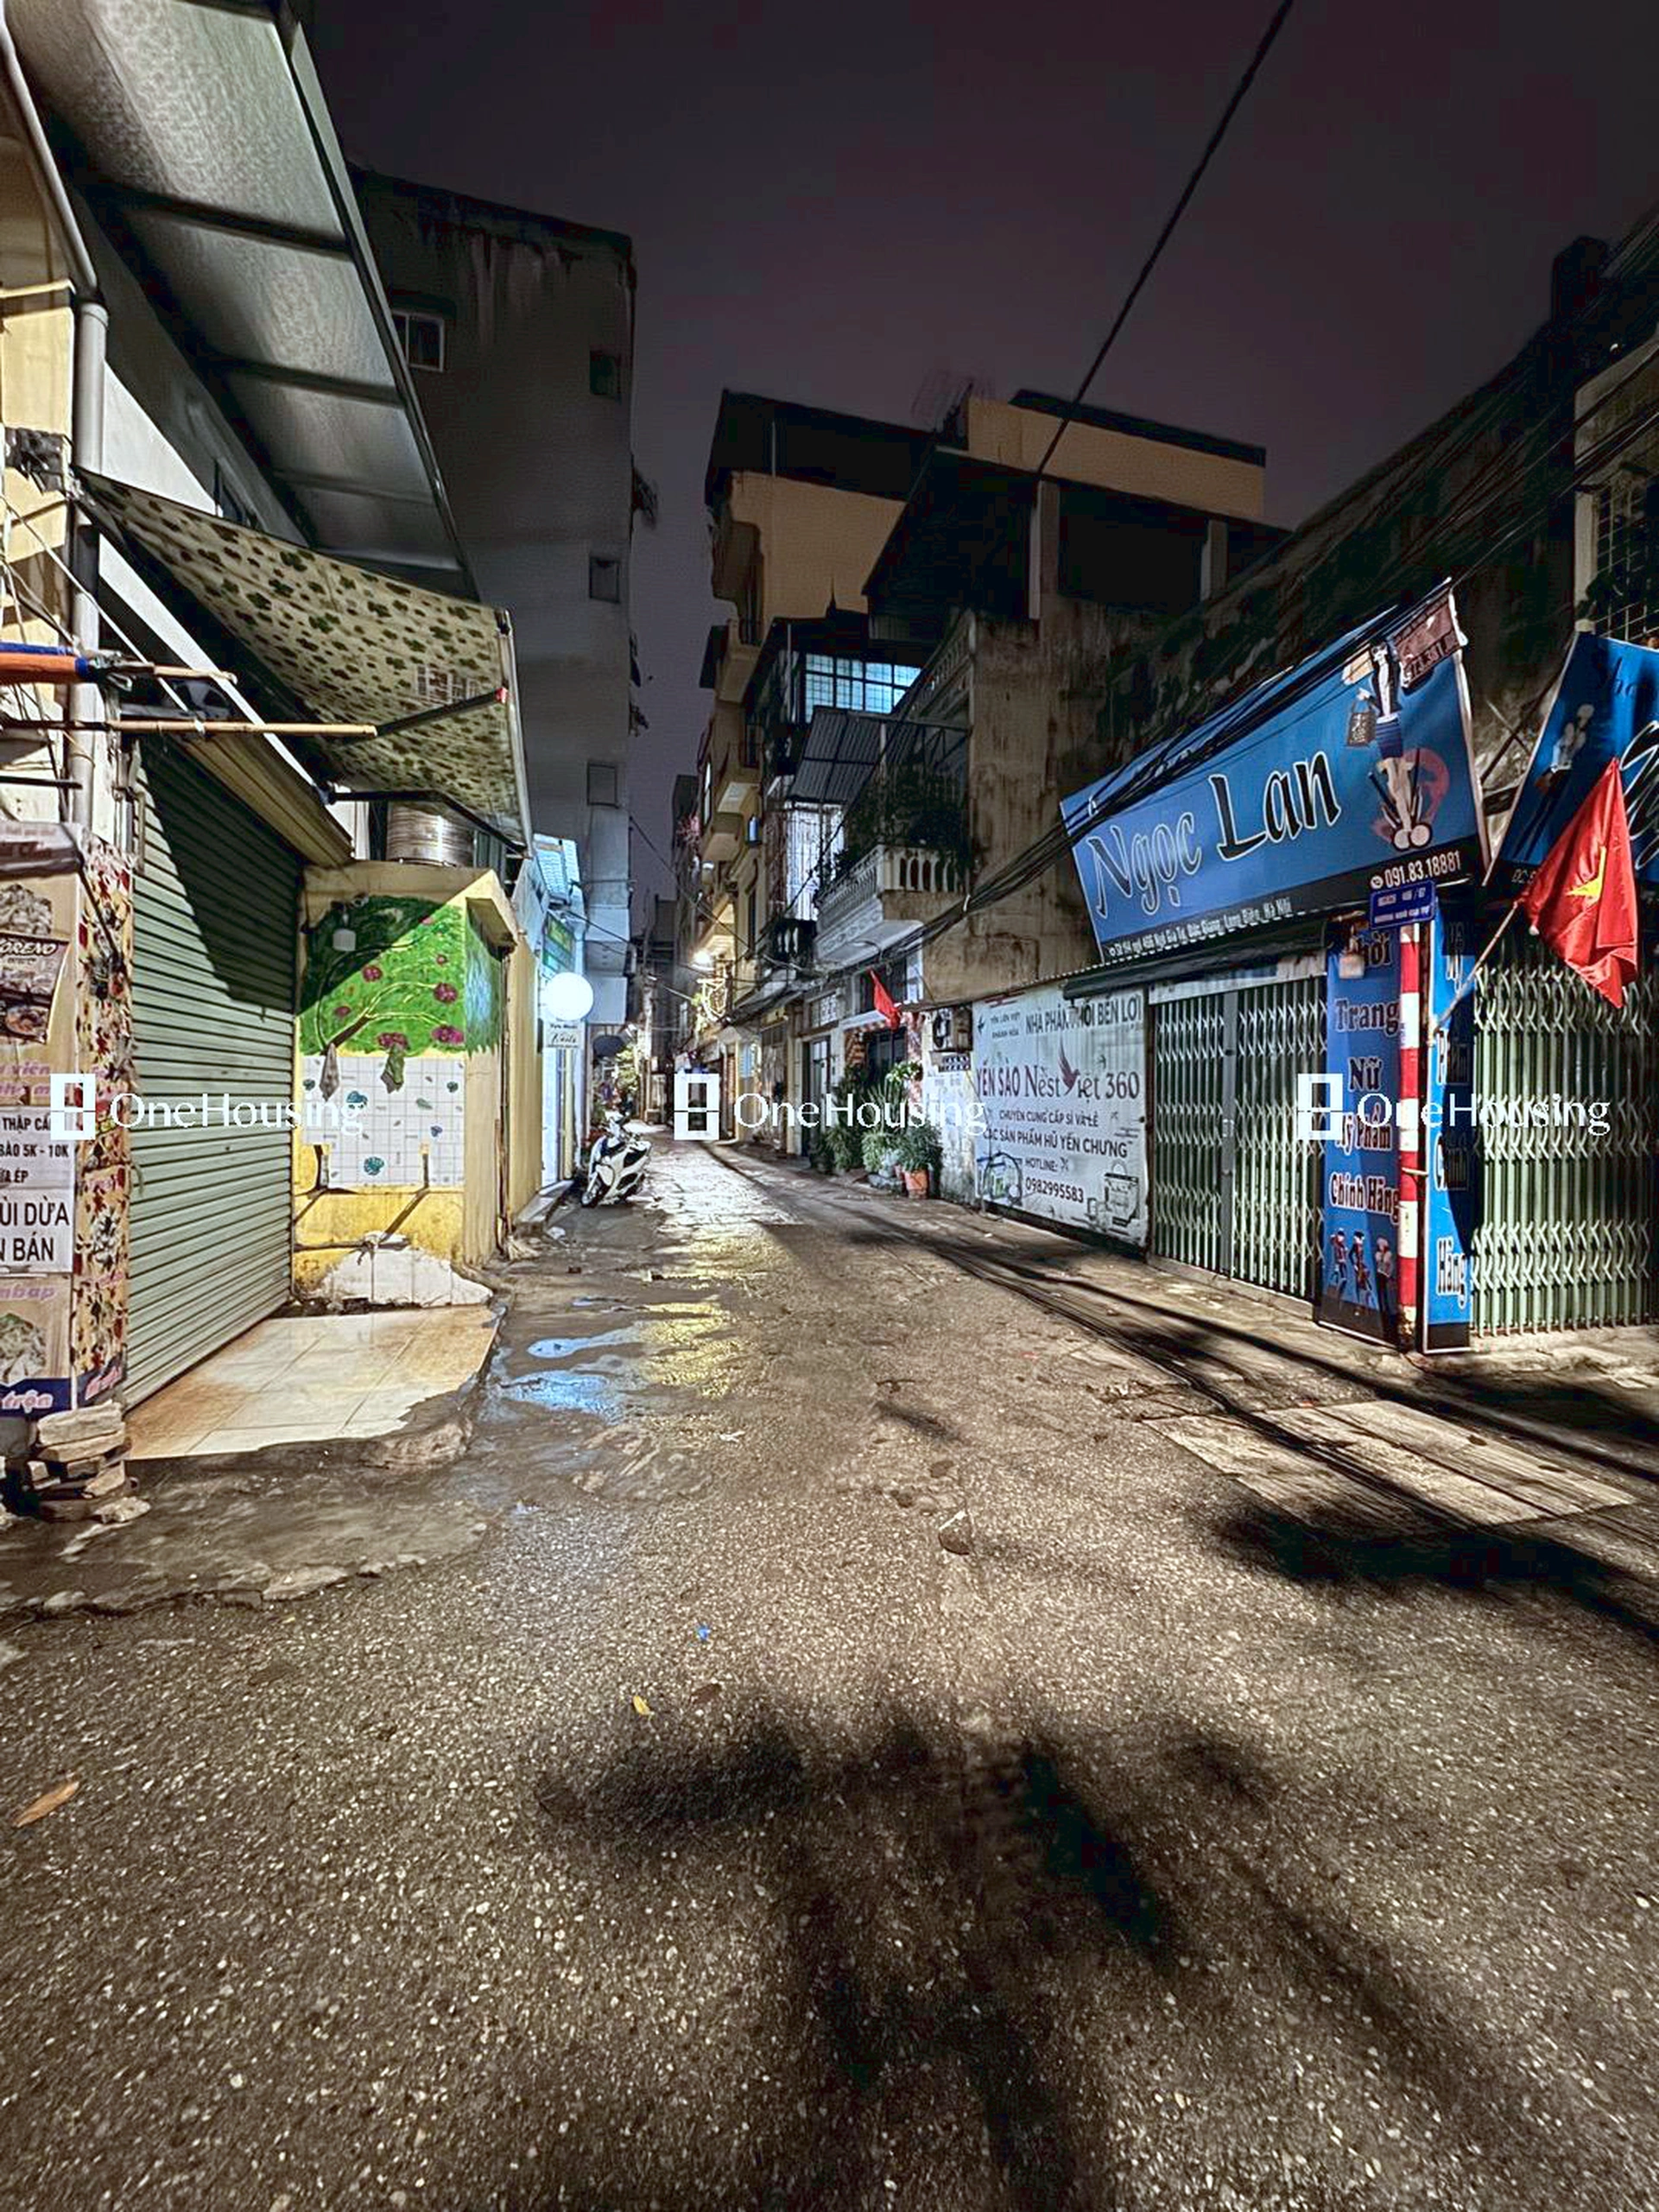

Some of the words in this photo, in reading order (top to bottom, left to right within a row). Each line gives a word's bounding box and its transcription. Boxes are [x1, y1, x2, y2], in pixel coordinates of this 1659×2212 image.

[1086, 812, 1201, 919] Ngọc
[1209, 751, 1341, 862] Lan
[1384, 850, 1460, 889] 091.83.18881
[1335, 998, 1400, 1037] Trang
[998, 1057, 1020, 1097] SÀO
[1105, 1071, 1140, 1100] 360
[1348, 1055, 1383, 1093] Nữ
[22, 1144, 37, 1157] 5K
[48, 1144, 69, 1158] 10K
[1082, 1138, 1128, 1159] CHƯNG
[14, 1167, 29, 1183] ÉP
[1025, 1176, 1084, 1203] 0982995583
[1329, 1171, 1366, 1212] Chính
[24, 1195, 70, 1226] DỪA
[13, 1231, 54, 1262] BÁN
